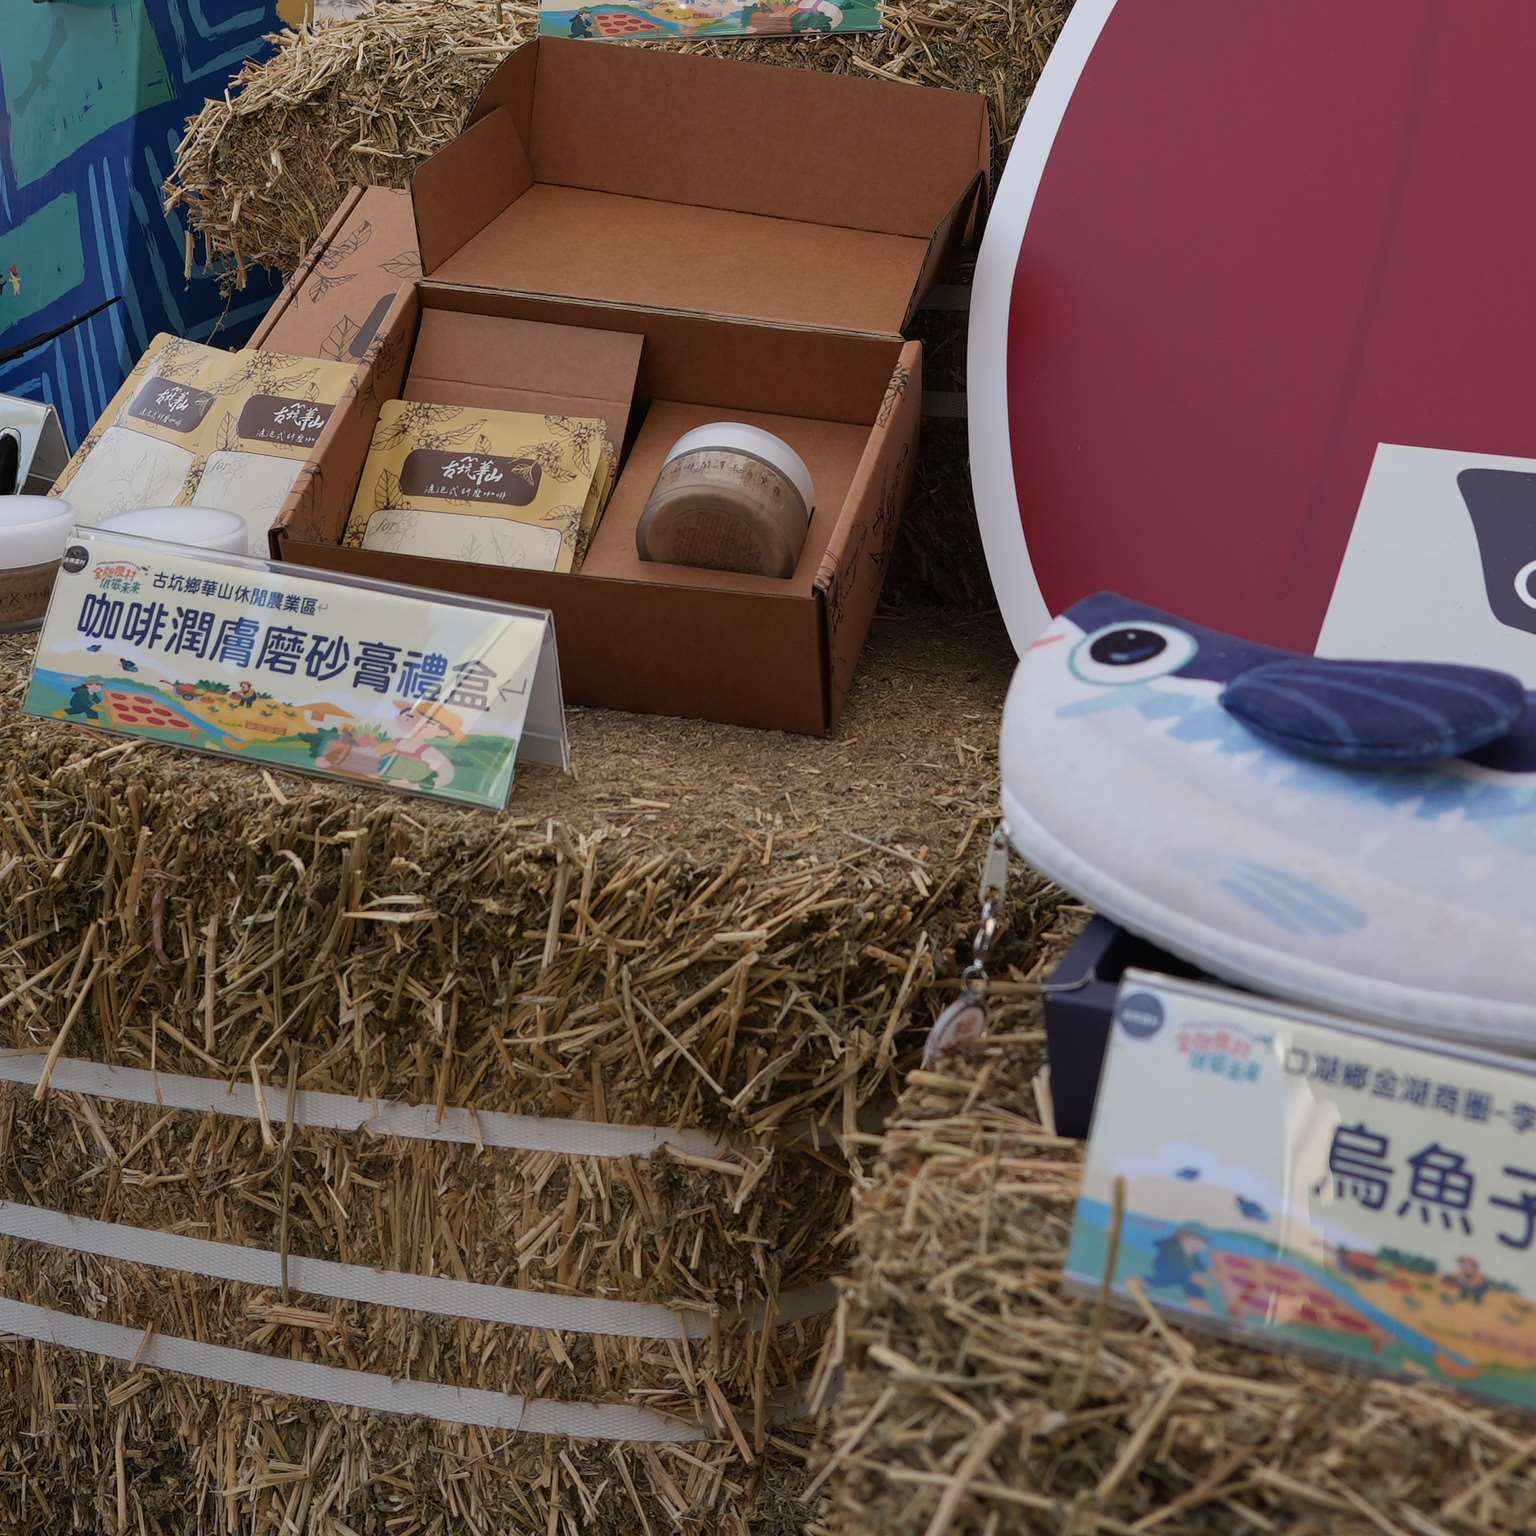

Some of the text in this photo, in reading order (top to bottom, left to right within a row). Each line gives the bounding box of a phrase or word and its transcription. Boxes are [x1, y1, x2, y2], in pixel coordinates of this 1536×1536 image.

[441, 456, 504, 484] 古坑華山
[153, 573, 317, 615] 古坑鄉華山休閒農業區
[78, 594, 499, 712] 咖啡潤膚磨砂膏禮盒
